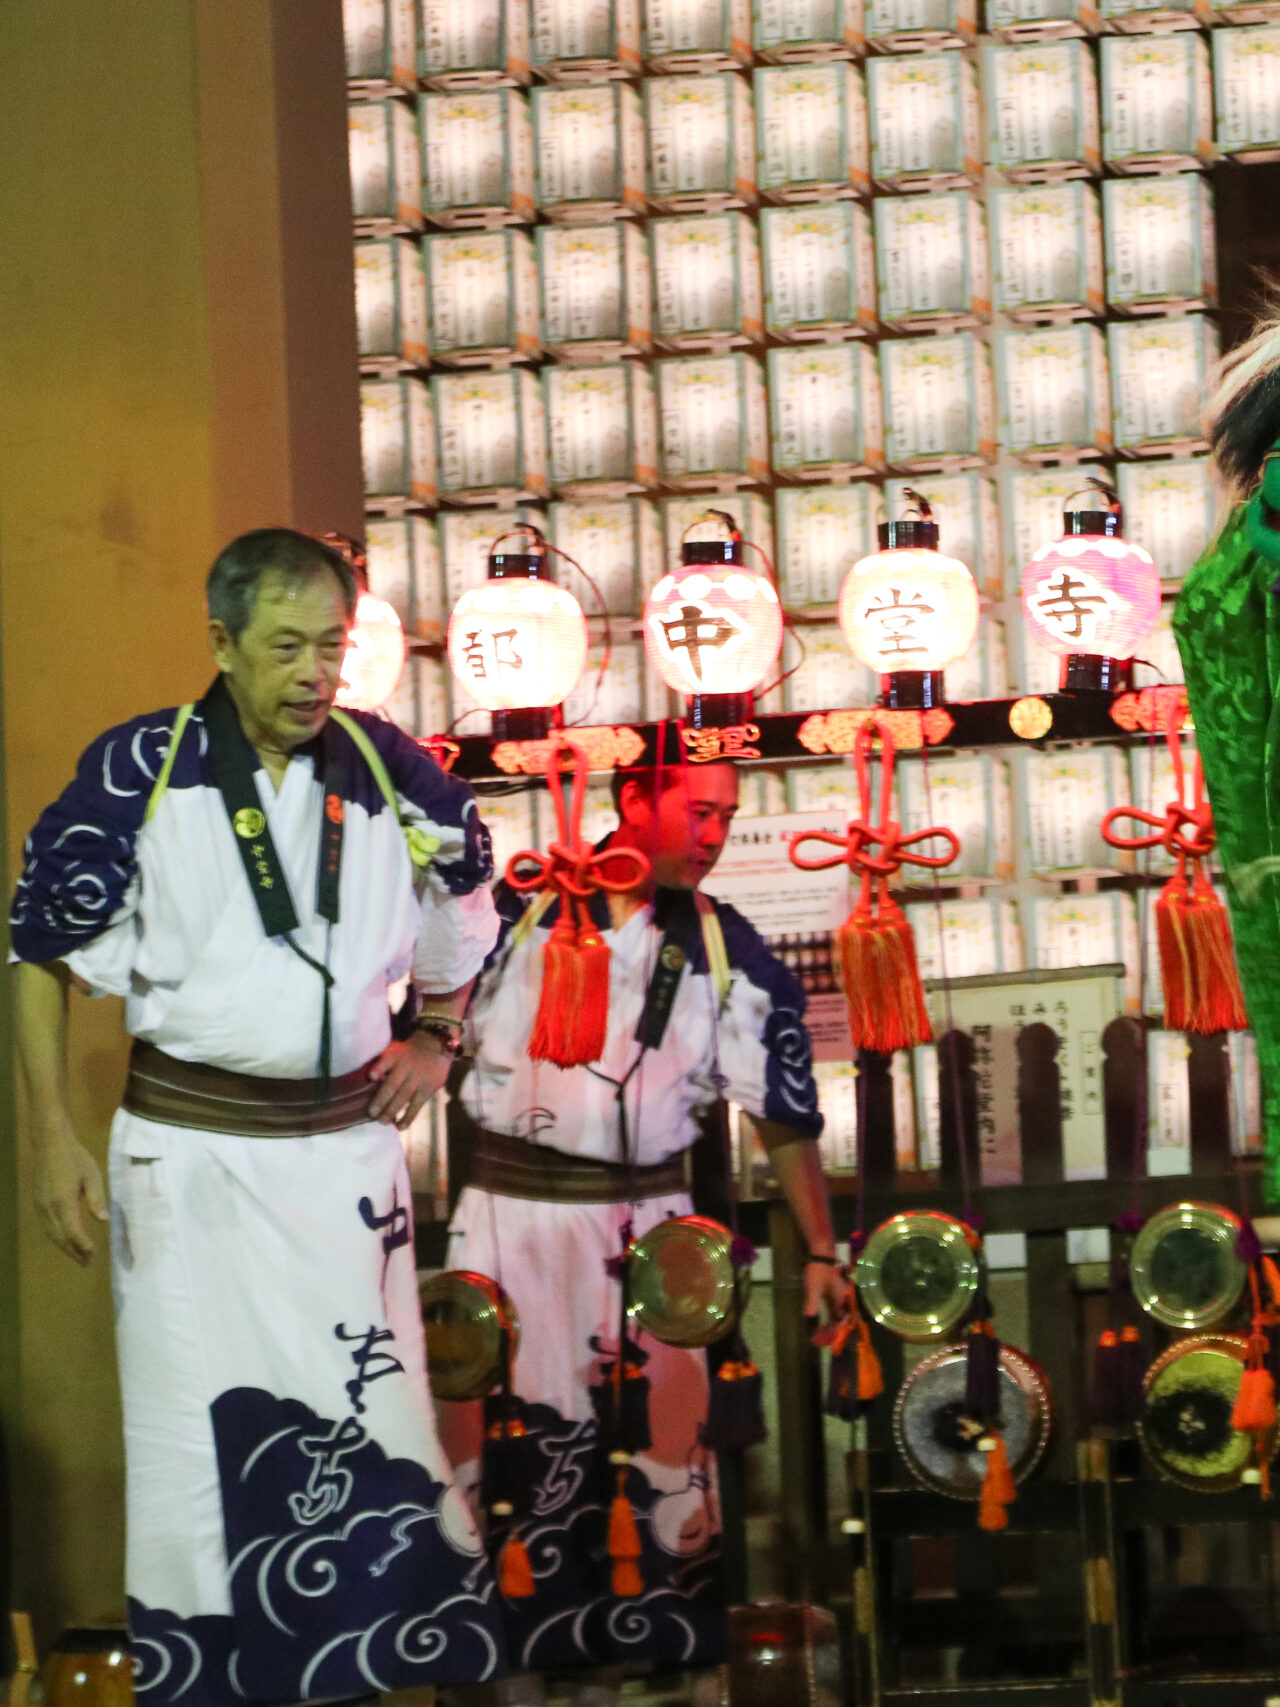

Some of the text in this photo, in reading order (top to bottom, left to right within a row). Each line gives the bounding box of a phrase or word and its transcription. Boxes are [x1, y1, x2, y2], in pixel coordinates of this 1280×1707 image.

[864, 587, 935, 656] 堂
[1036, 572, 1107, 639] 寺
[661, 605, 741, 682] 中
